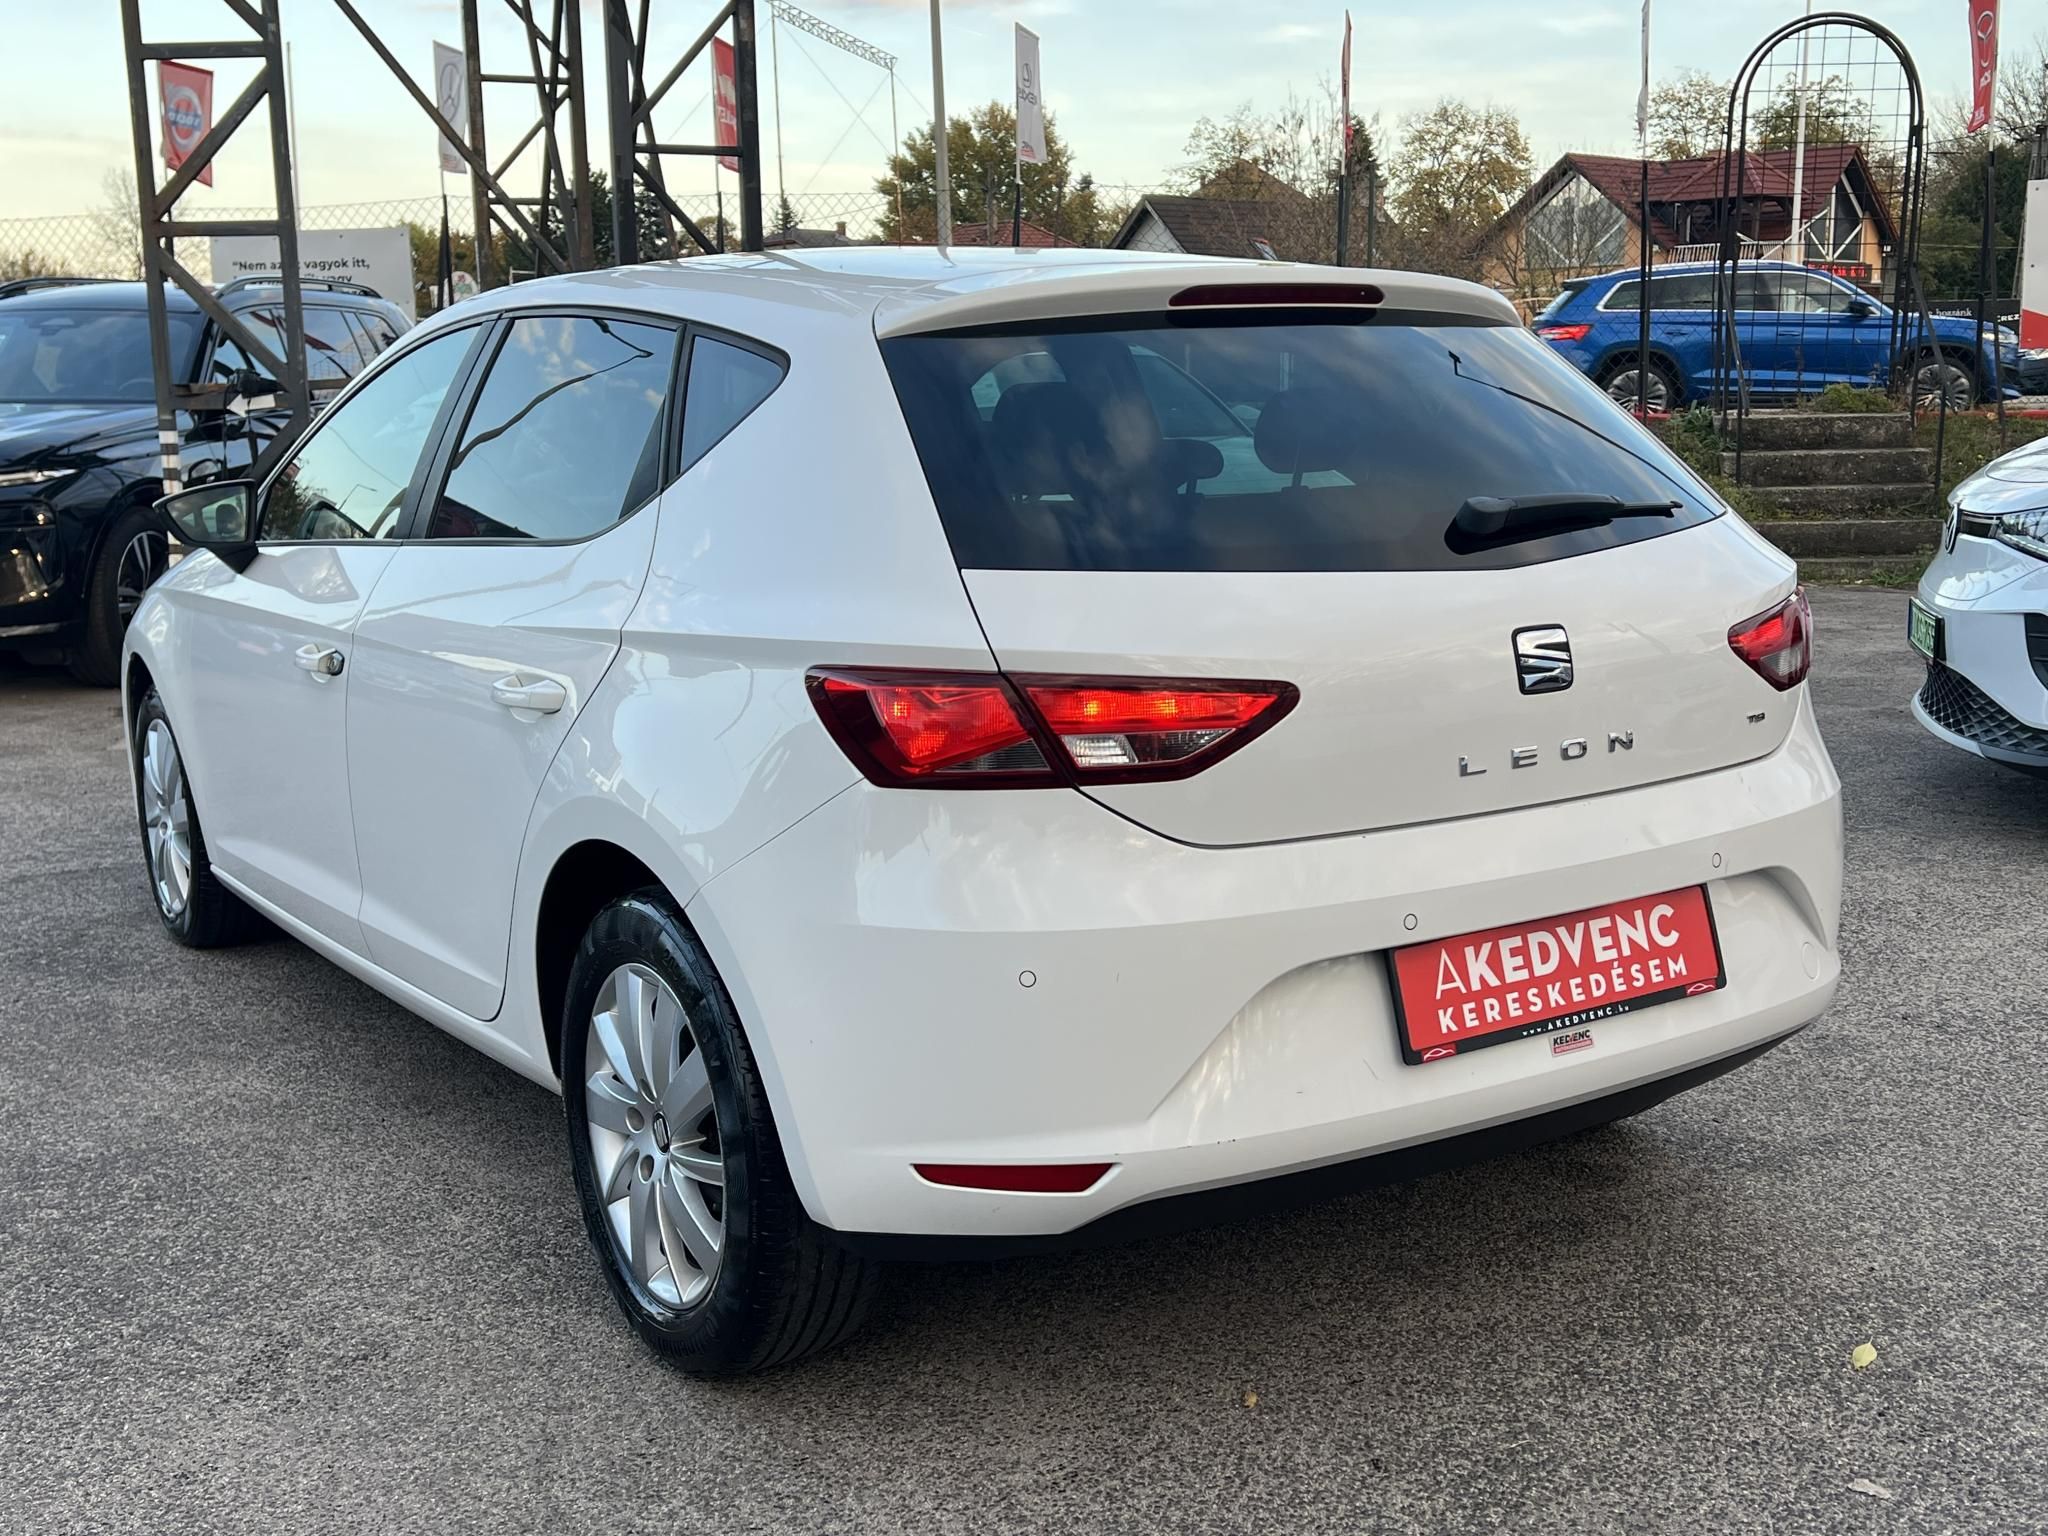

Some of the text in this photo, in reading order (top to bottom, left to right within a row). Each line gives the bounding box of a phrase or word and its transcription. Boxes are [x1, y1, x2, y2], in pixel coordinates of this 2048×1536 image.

[304, 258, 349, 271] vagyok
[352, 256, 370, 269] itt,
[1459, 730, 1634, 777] LEON
[1437, 953, 1688, 1034] KERESKEDÉSEM
[1522, 1004, 1629, 1036] www.AKEDVENC.hu
